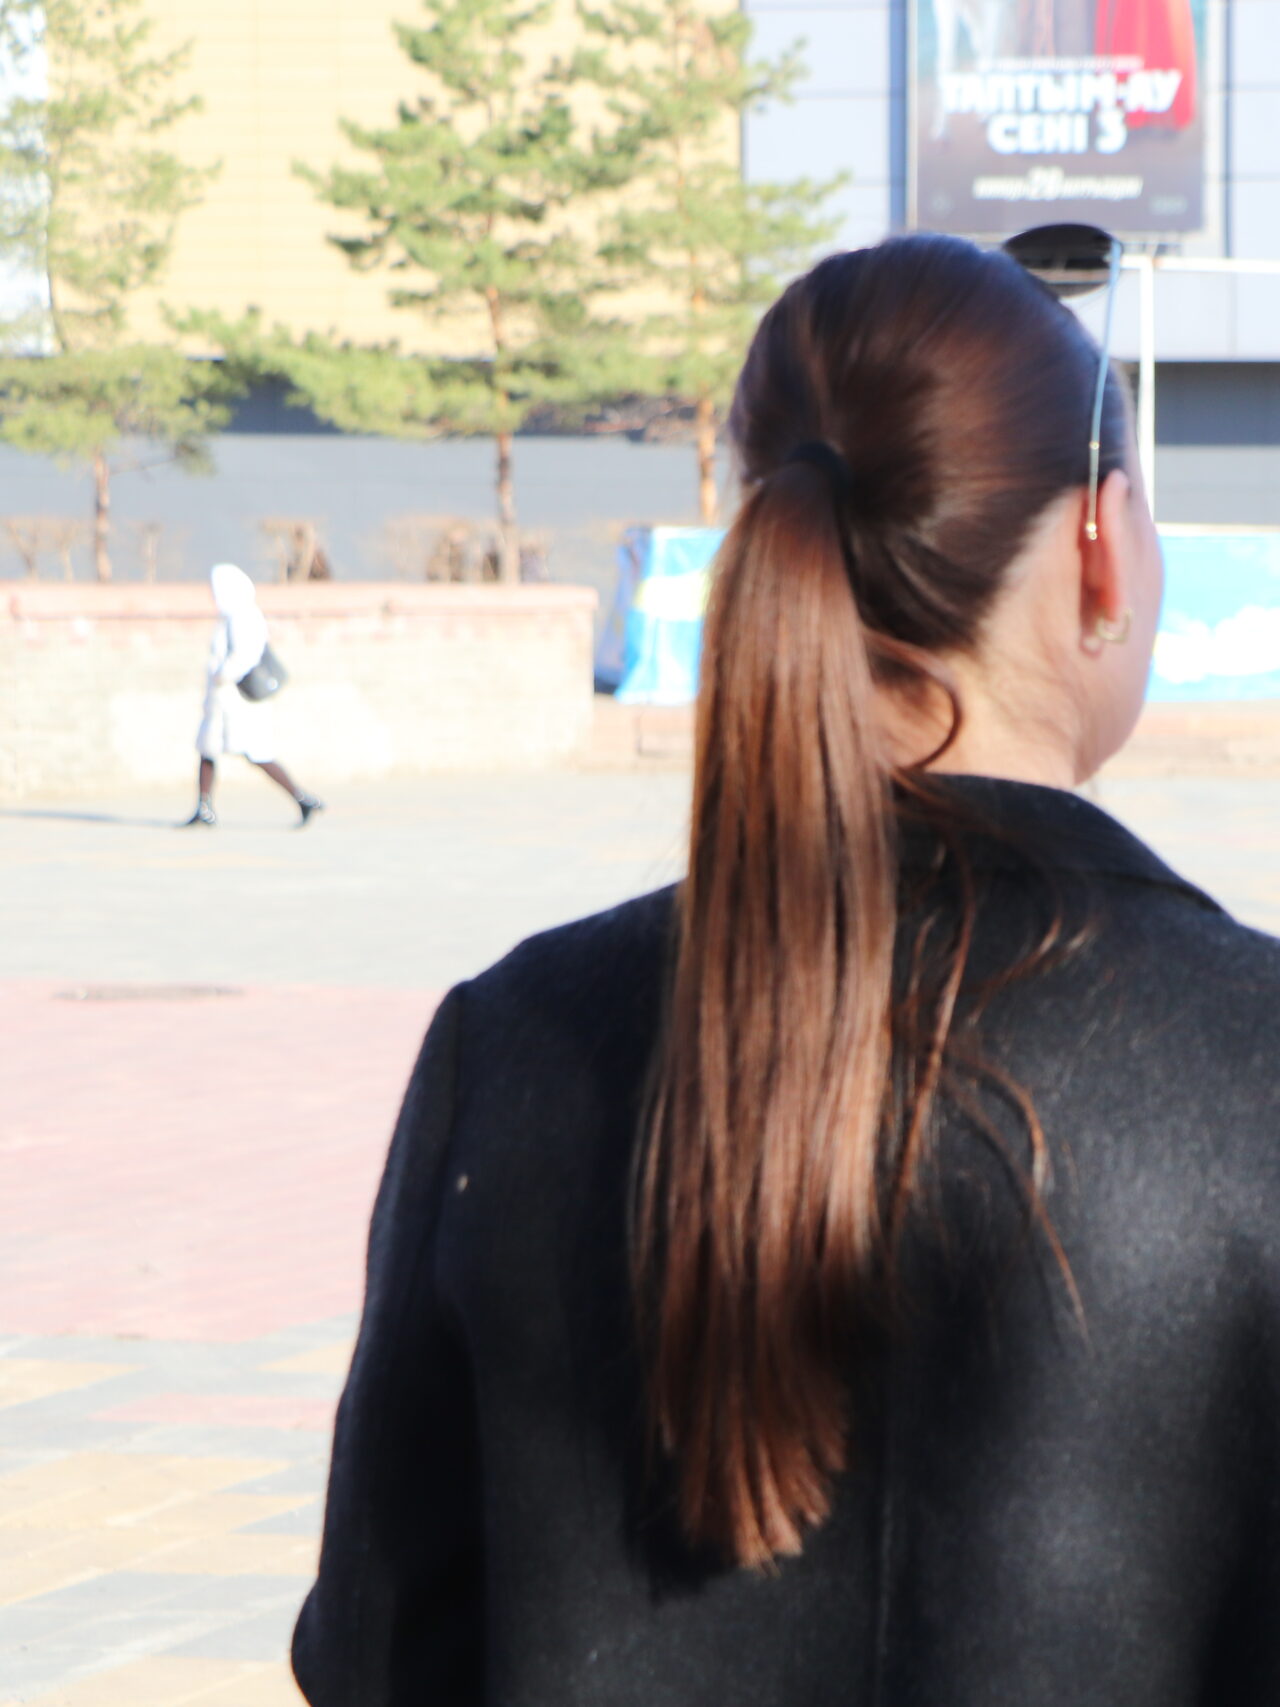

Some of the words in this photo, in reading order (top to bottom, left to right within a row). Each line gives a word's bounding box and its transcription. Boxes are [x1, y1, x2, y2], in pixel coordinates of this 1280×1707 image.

[943, 69, 1183, 113] ТАПТЫМ-АУ
[986, 112, 1089, 153] СЕНІ
[1096, 110, 1128, 153] 3
